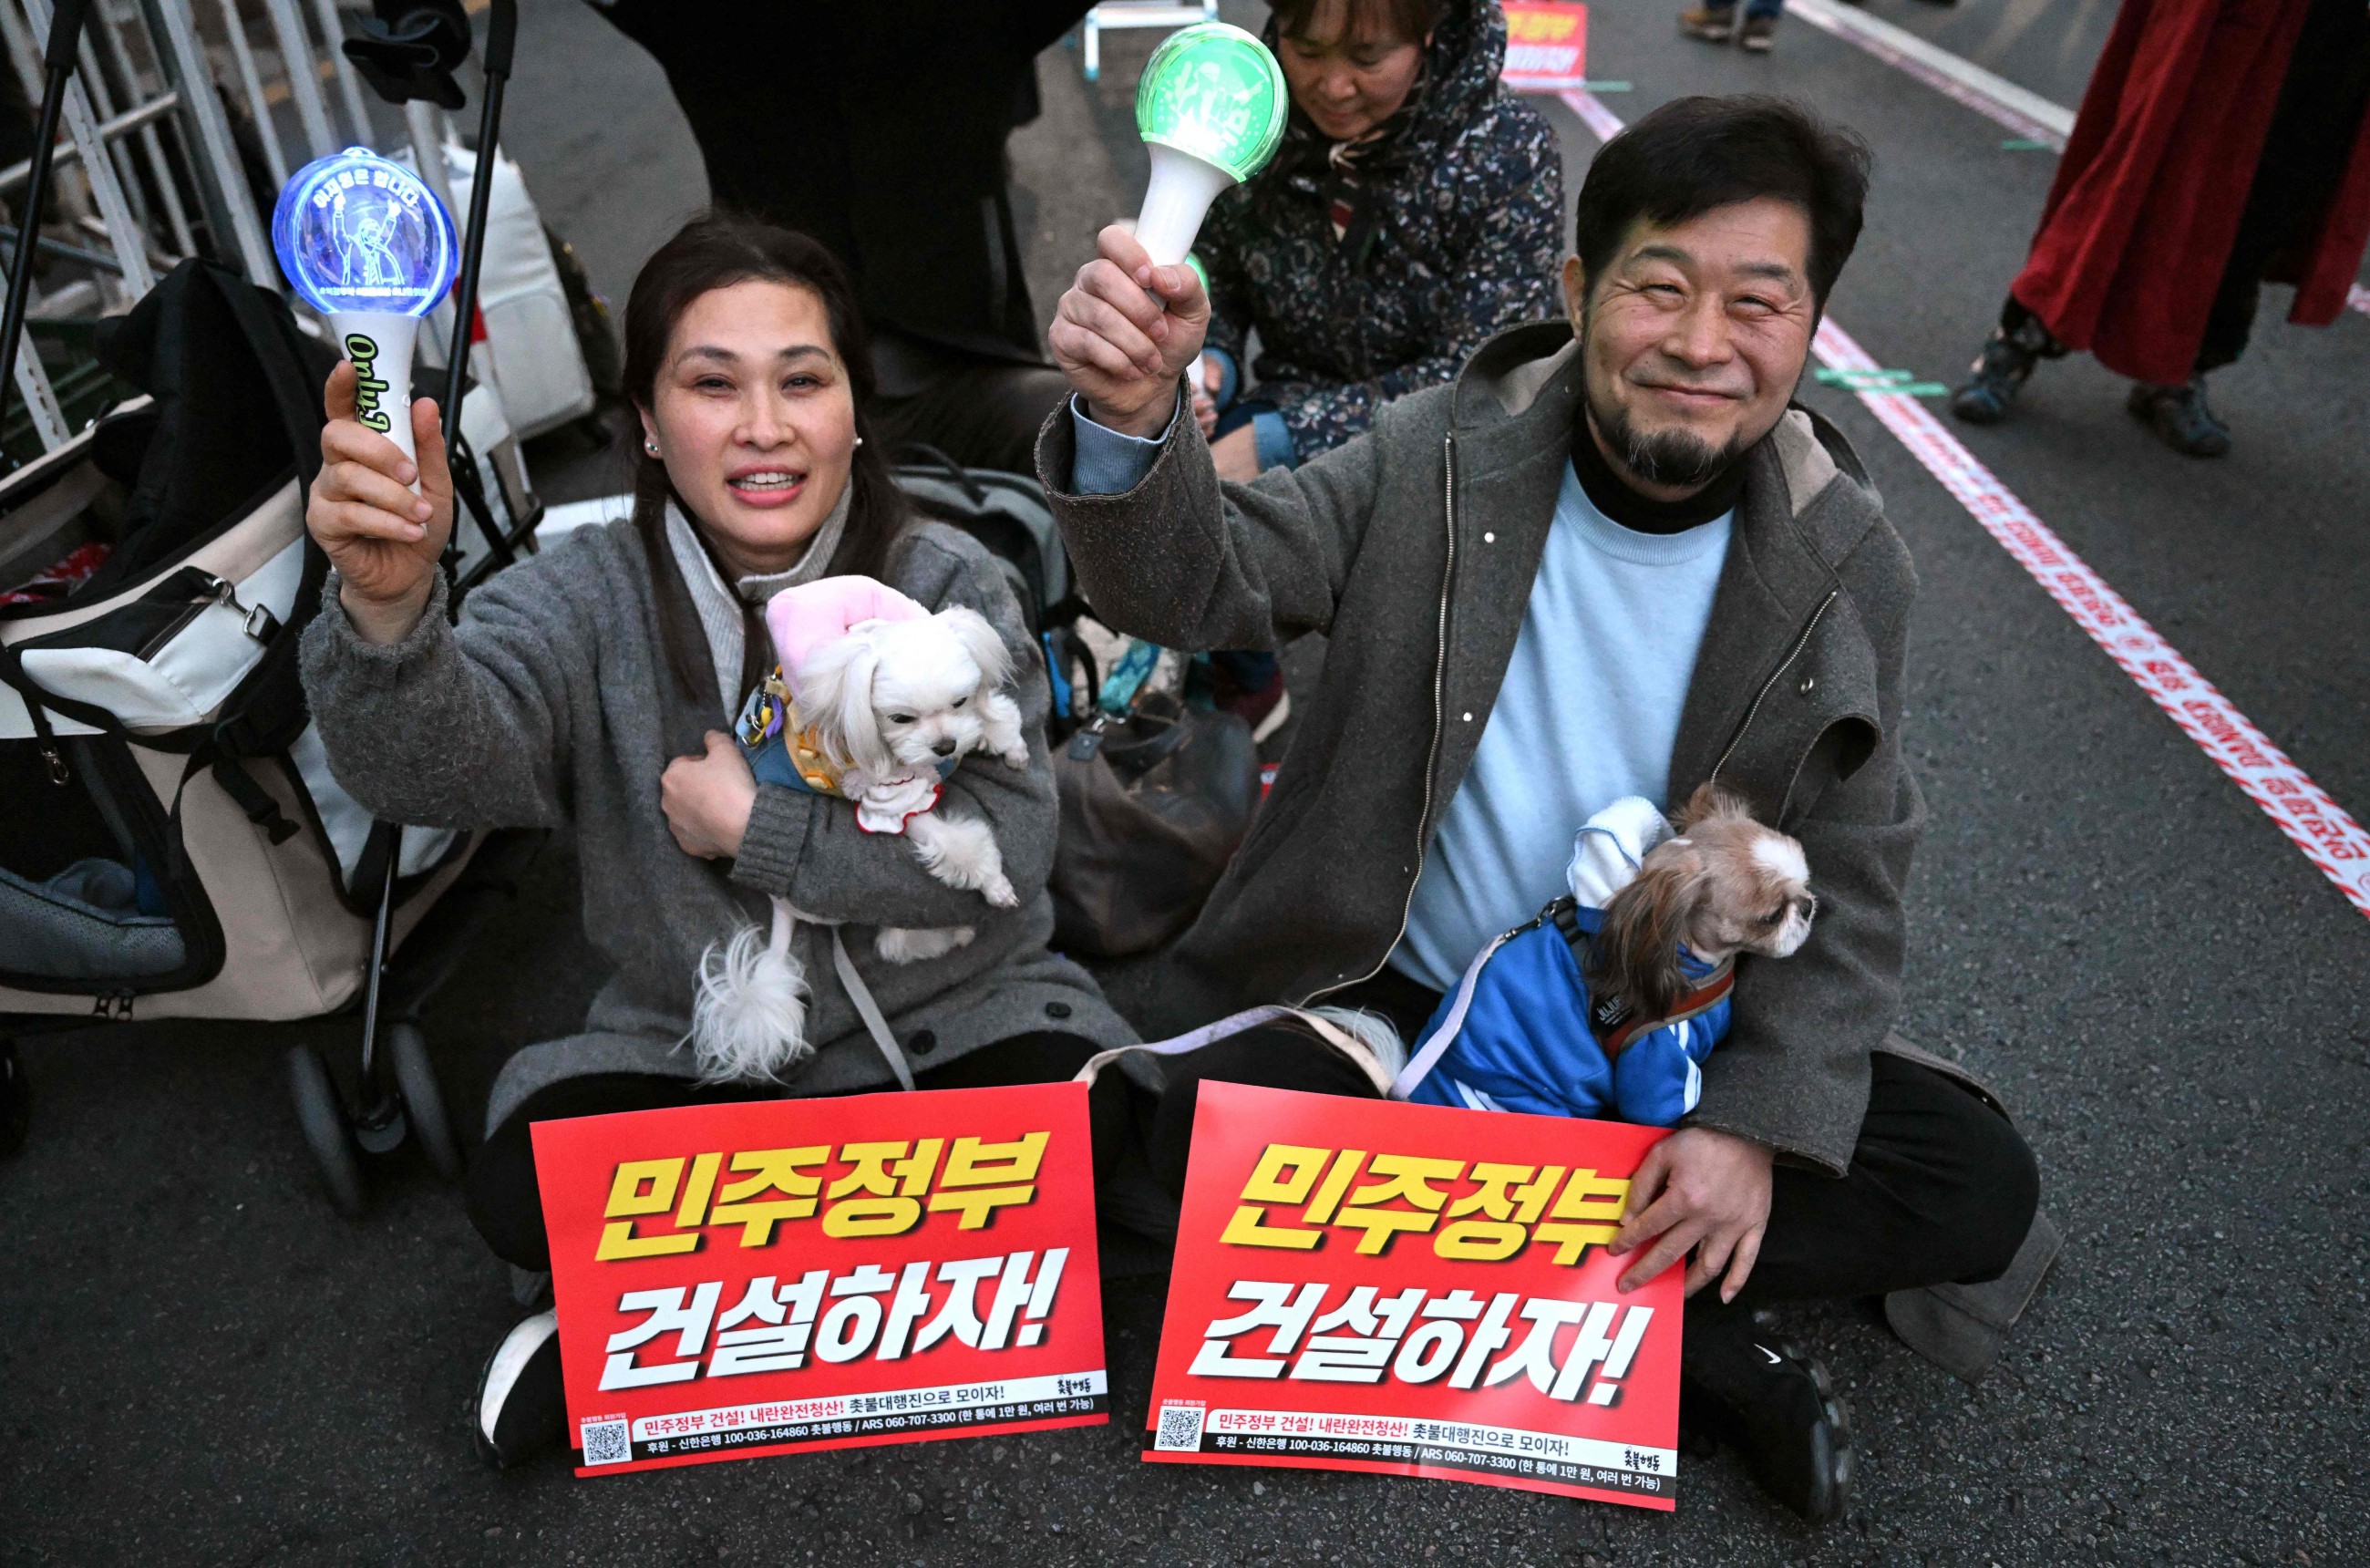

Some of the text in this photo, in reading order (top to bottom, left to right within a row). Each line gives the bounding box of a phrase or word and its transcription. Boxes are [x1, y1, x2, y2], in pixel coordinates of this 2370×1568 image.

[313, 169, 419, 208] 이재명은 합니다
[594, 1131, 1050, 1261] 민주정부
[1219, 1143, 1634, 1265] 민주정부
[598, 1247, 1069, 1391] 건설하자!
[1187, 1280, 1654, 1406] 건설하자!
[644, 1385, 1005, 1436] 민주정부 건설! 내란완전청산! 촛불대행진으로 모이자!
[1057, 1375, 1091, 1395] 촛불행동
[646, 1441, 669, 1453] 후원
[679, 1434, 722, 1450] 신한은행
[725, 1426, 809, 1444] 100-036-164860
[810, 1421, 852, 1436] 촛불행동
[854, 1420, 860, 1432] /
[861, 1418, 883, 1430] ARS
[885, 1412, 955, 1428] 060-707-3300
[958, 1410, 972, 1423] (한
[974, 1407, 996, 1420] 통에
[998, 1405, 1015, 1418] 1만
[1017, 1404, 1031, 1417] 원,
[1033, 1401, 1054, 1415] 여러
[1056, 1400, 1067, 1411] 번
[1070, 1398, 1094, 1411] 가능)
[1219, 1413, 1569, 1456] 민주정부 건설! 내란완전청산! 촛불대행진으로 모이자!
[1216, 1435, 1237, 1449] 후원
[1246, 1436, 1287, 1450] 신한은행
[1289, 1439, 1370, 1454] 100-036-164860
[1372, 1443, 1412, 1458] 촛불행동
[1414, 1447, 1419, 1459] /
[1421, 1447, 1442, 1460] ARS
[1445, 1450, 1516, 1470] 060-707-3300
[1519, 1459, 1533, 1473] (한
[1536, 1461, 1557, 1475] 통에
[1560, 1465, 1577, 1479] 1만
[1580, 1468, 1594, 1482] 원,
[1596, 1470, 1618, 1484] 여러
[1621, 1473, 1632, 1486] 번
[1634, 1475, 1660, 1492] 가능)
[1624, 1446, 1660, 1471] 촛불행동
